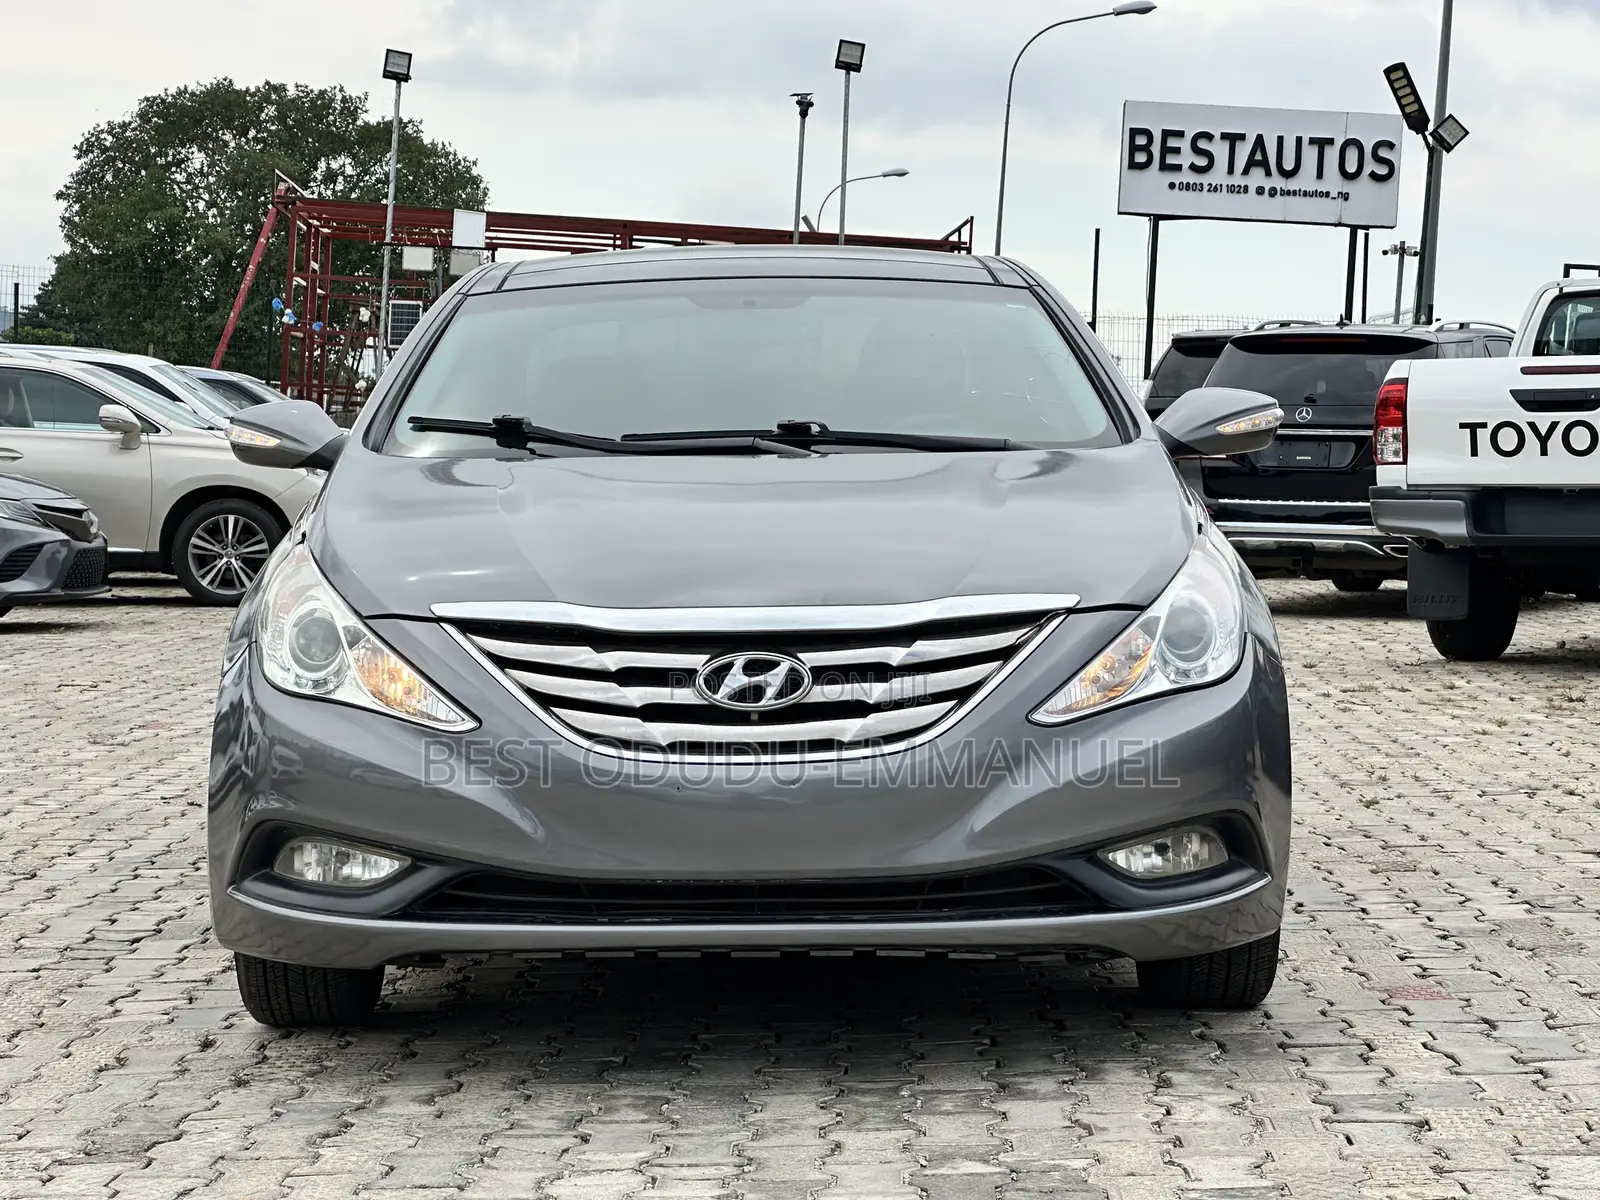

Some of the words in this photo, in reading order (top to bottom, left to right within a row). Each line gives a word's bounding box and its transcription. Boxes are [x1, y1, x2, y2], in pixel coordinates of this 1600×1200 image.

[1127, 127, 1397, 182] BESTAUTOS
[1178, 181, 1204, 192] 0803
[1207, 183, 1223, 193] 261
[1226, 183, 1249, 195] 1028
[1459, 419, 1600, 457] TOYO
